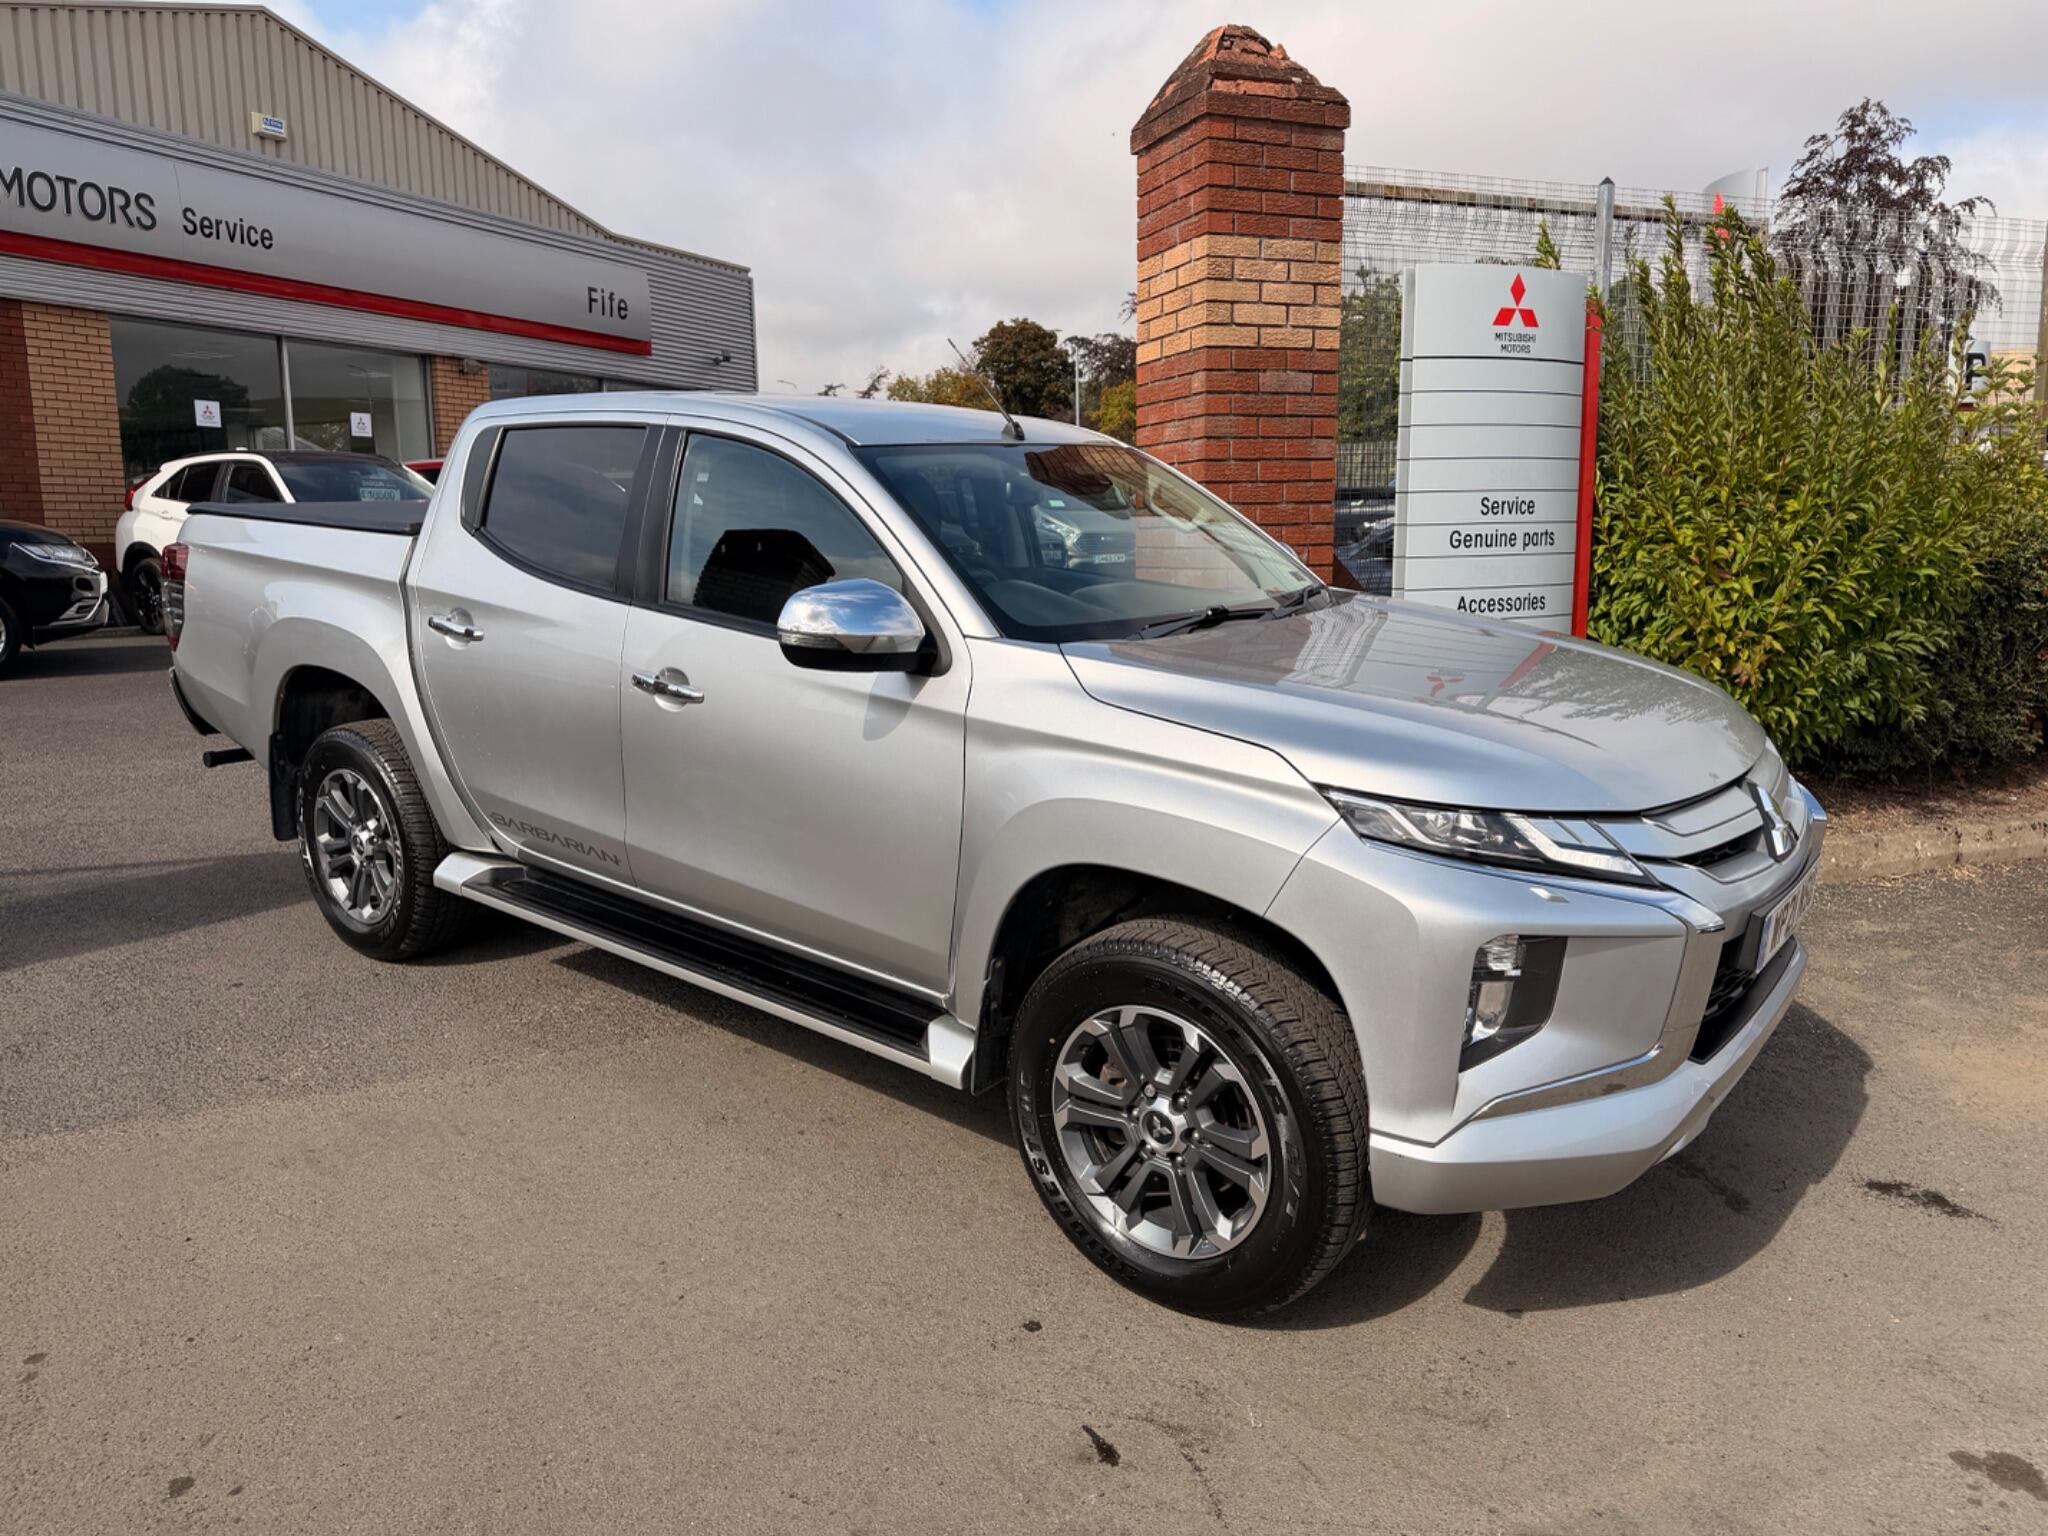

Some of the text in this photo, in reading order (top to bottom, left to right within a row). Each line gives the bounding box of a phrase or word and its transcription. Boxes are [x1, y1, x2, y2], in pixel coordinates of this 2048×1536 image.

[0, 167, 157, 230] MOTORS
[182, 207, 274, 250] Service
[587, 286, 628, 320] Fife
[1494, 332, 1537, 342] MITSUBISHI
[1501, 343, 1531, 354] MOTORS
[1480, 496, 1536, 516] Service
[1450, 528, 1556, 551] Genuine parts
[1457, 593, 1547, 613] Accessories
[490, 811, 623, 866] BARBARIAN
[1144, 976, 1288, 1116] DUELER
[1017, 1070, 1143, 1282] BRIDGESTONE
